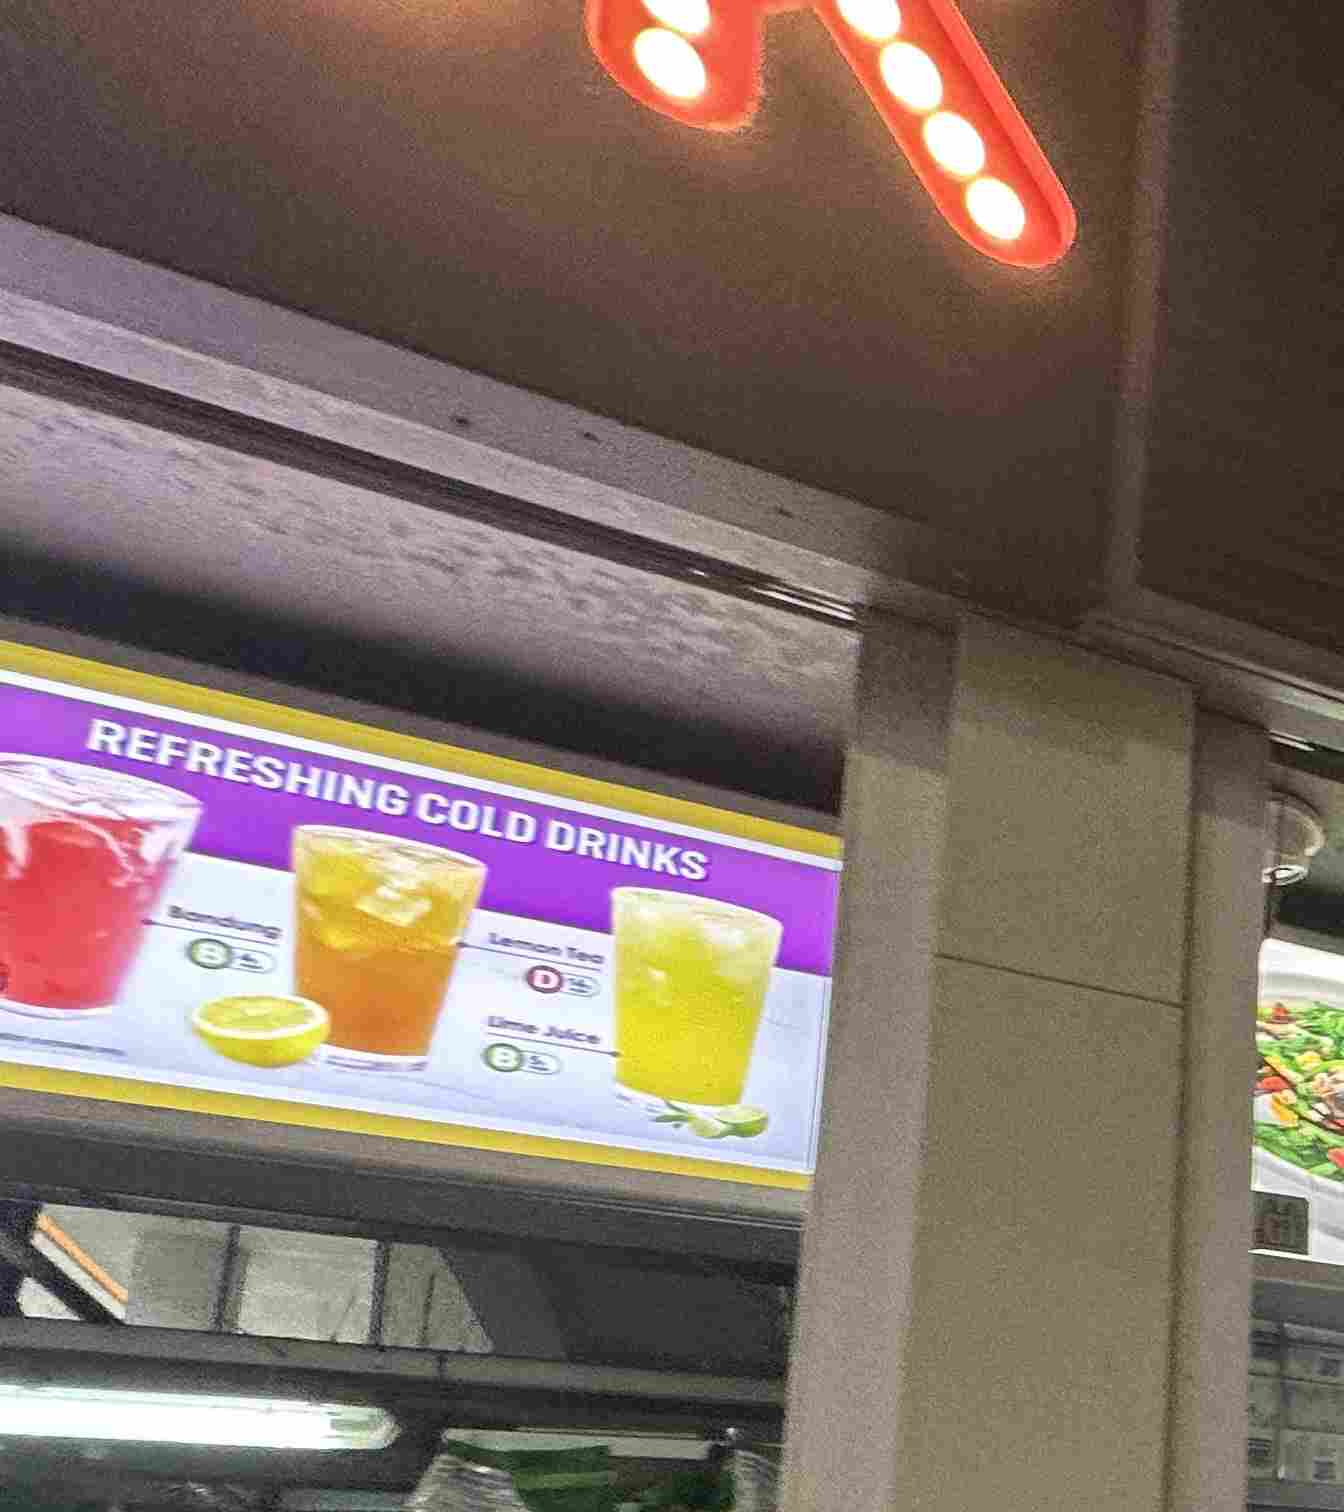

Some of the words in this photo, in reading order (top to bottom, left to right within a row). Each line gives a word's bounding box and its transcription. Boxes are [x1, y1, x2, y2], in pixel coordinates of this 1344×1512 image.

[86, 718, 407, 817] REFRESHING
[418, 791, 537, 846] COLD
[545, 820, 708, 881] DRINKS
[168, 904, 283, 940] Bandung
[487, 931, 563, 957] Lemon
[567, 945, 605, 964] Tea
[487, 1015, 539, 1034] Lime
[543, 1025, 601, 1045] Juice
